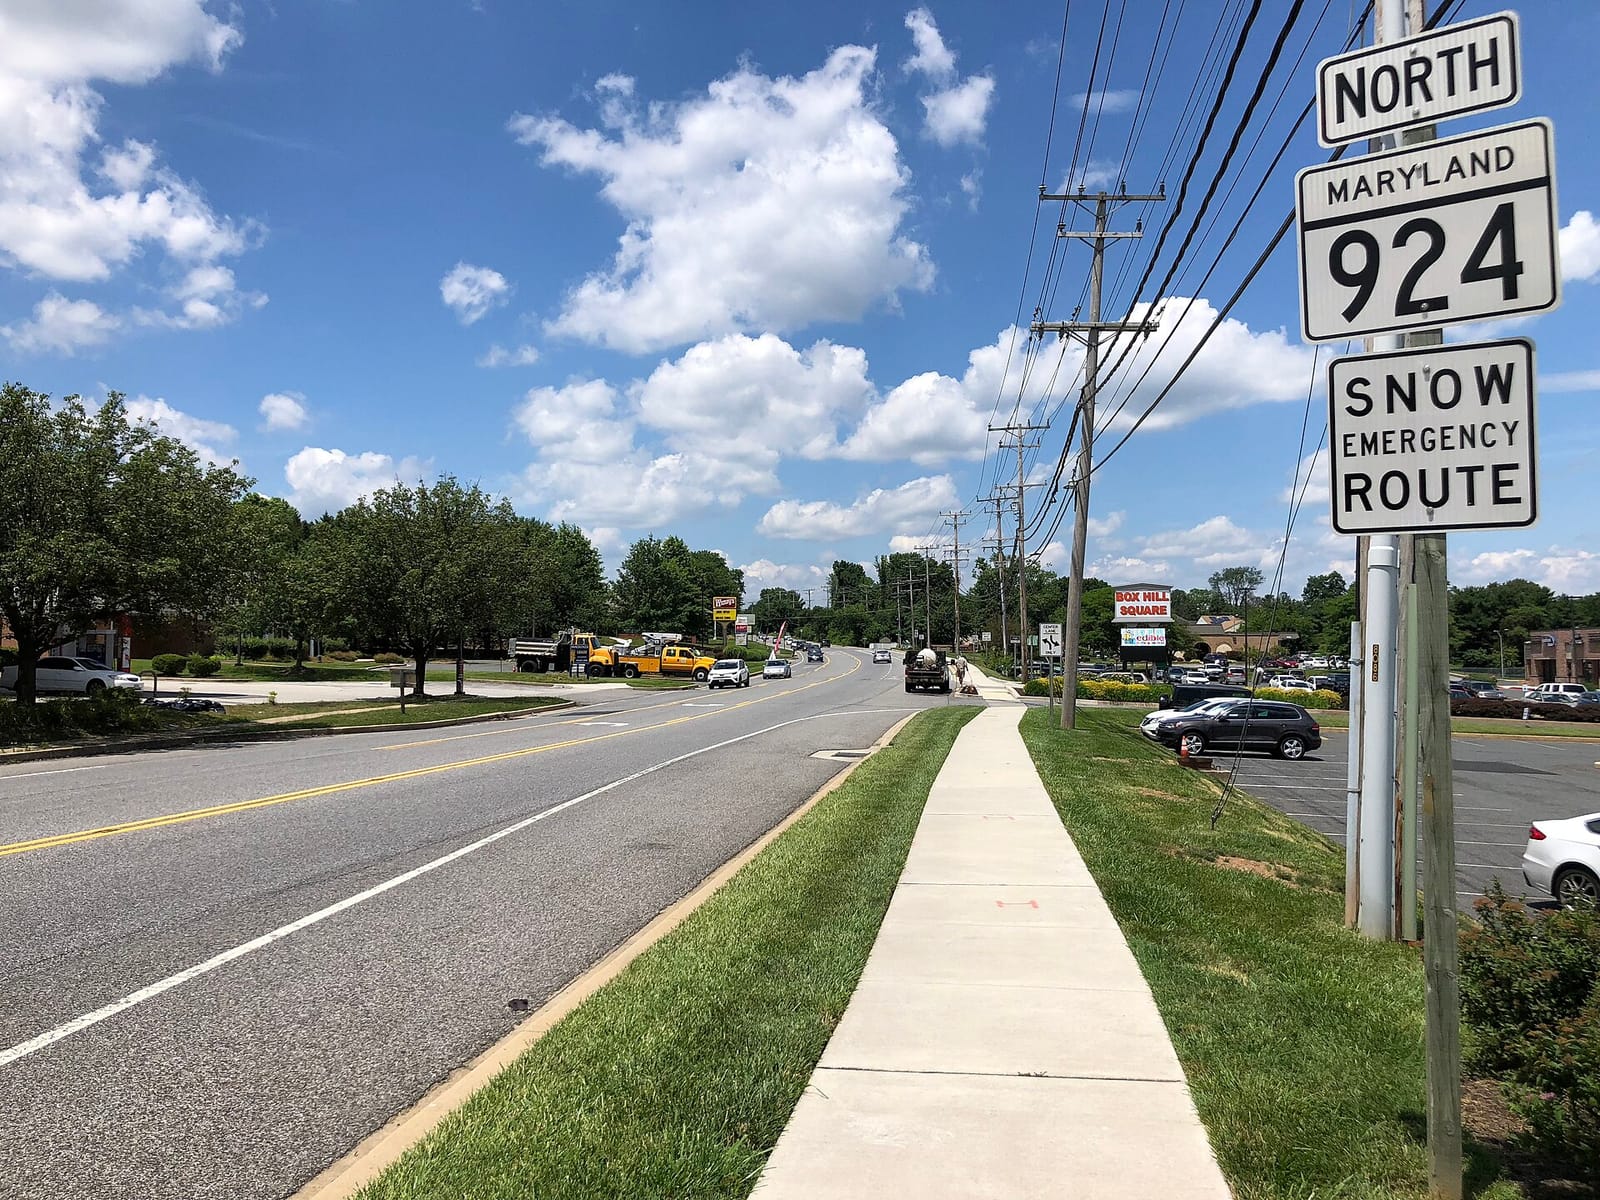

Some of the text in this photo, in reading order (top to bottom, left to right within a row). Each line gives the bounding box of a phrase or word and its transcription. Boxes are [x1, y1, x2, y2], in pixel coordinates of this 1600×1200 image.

[1335, 37, 1500, 124] NORTH
[1328, 145, 1515, 206] MARYLAND
[1329, 202, 1524, 323] 924
[1344, 362, 1515, 417] SNOW
[1343, 420, 1520, 458] EMERGENCY
[1344, 463, 1522, 513] ROUTE
[1115, 592, 1170, 602] BOX HILL
[1120, 605, 1168, 616] SQUARE
